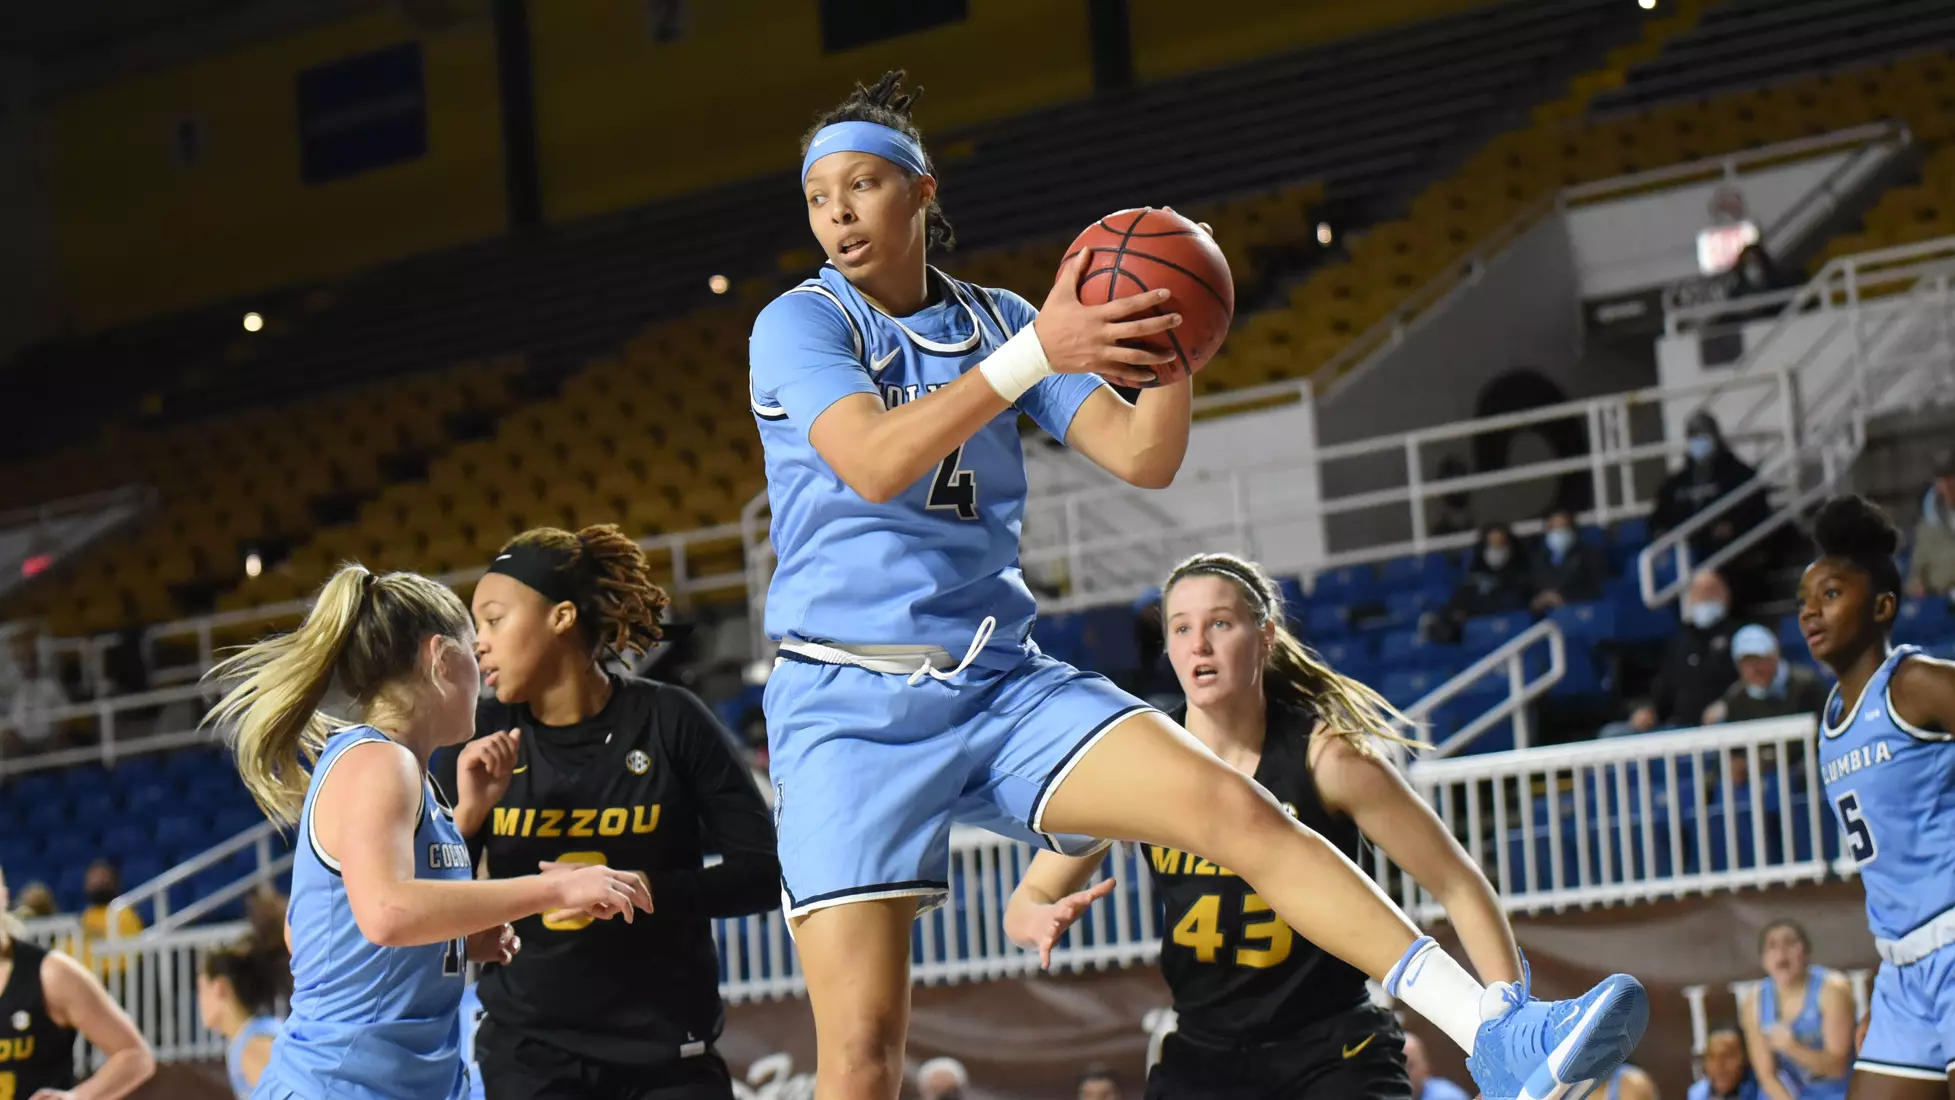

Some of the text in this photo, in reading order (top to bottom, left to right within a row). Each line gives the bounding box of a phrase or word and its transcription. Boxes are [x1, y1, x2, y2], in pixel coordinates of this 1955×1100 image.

[925, 442, 979, 520] 4
[493, 804, 661, 837] MIZZOU
[1836, 789, 1879, 867] 5
[1172, 894, 1293, 968] 43
